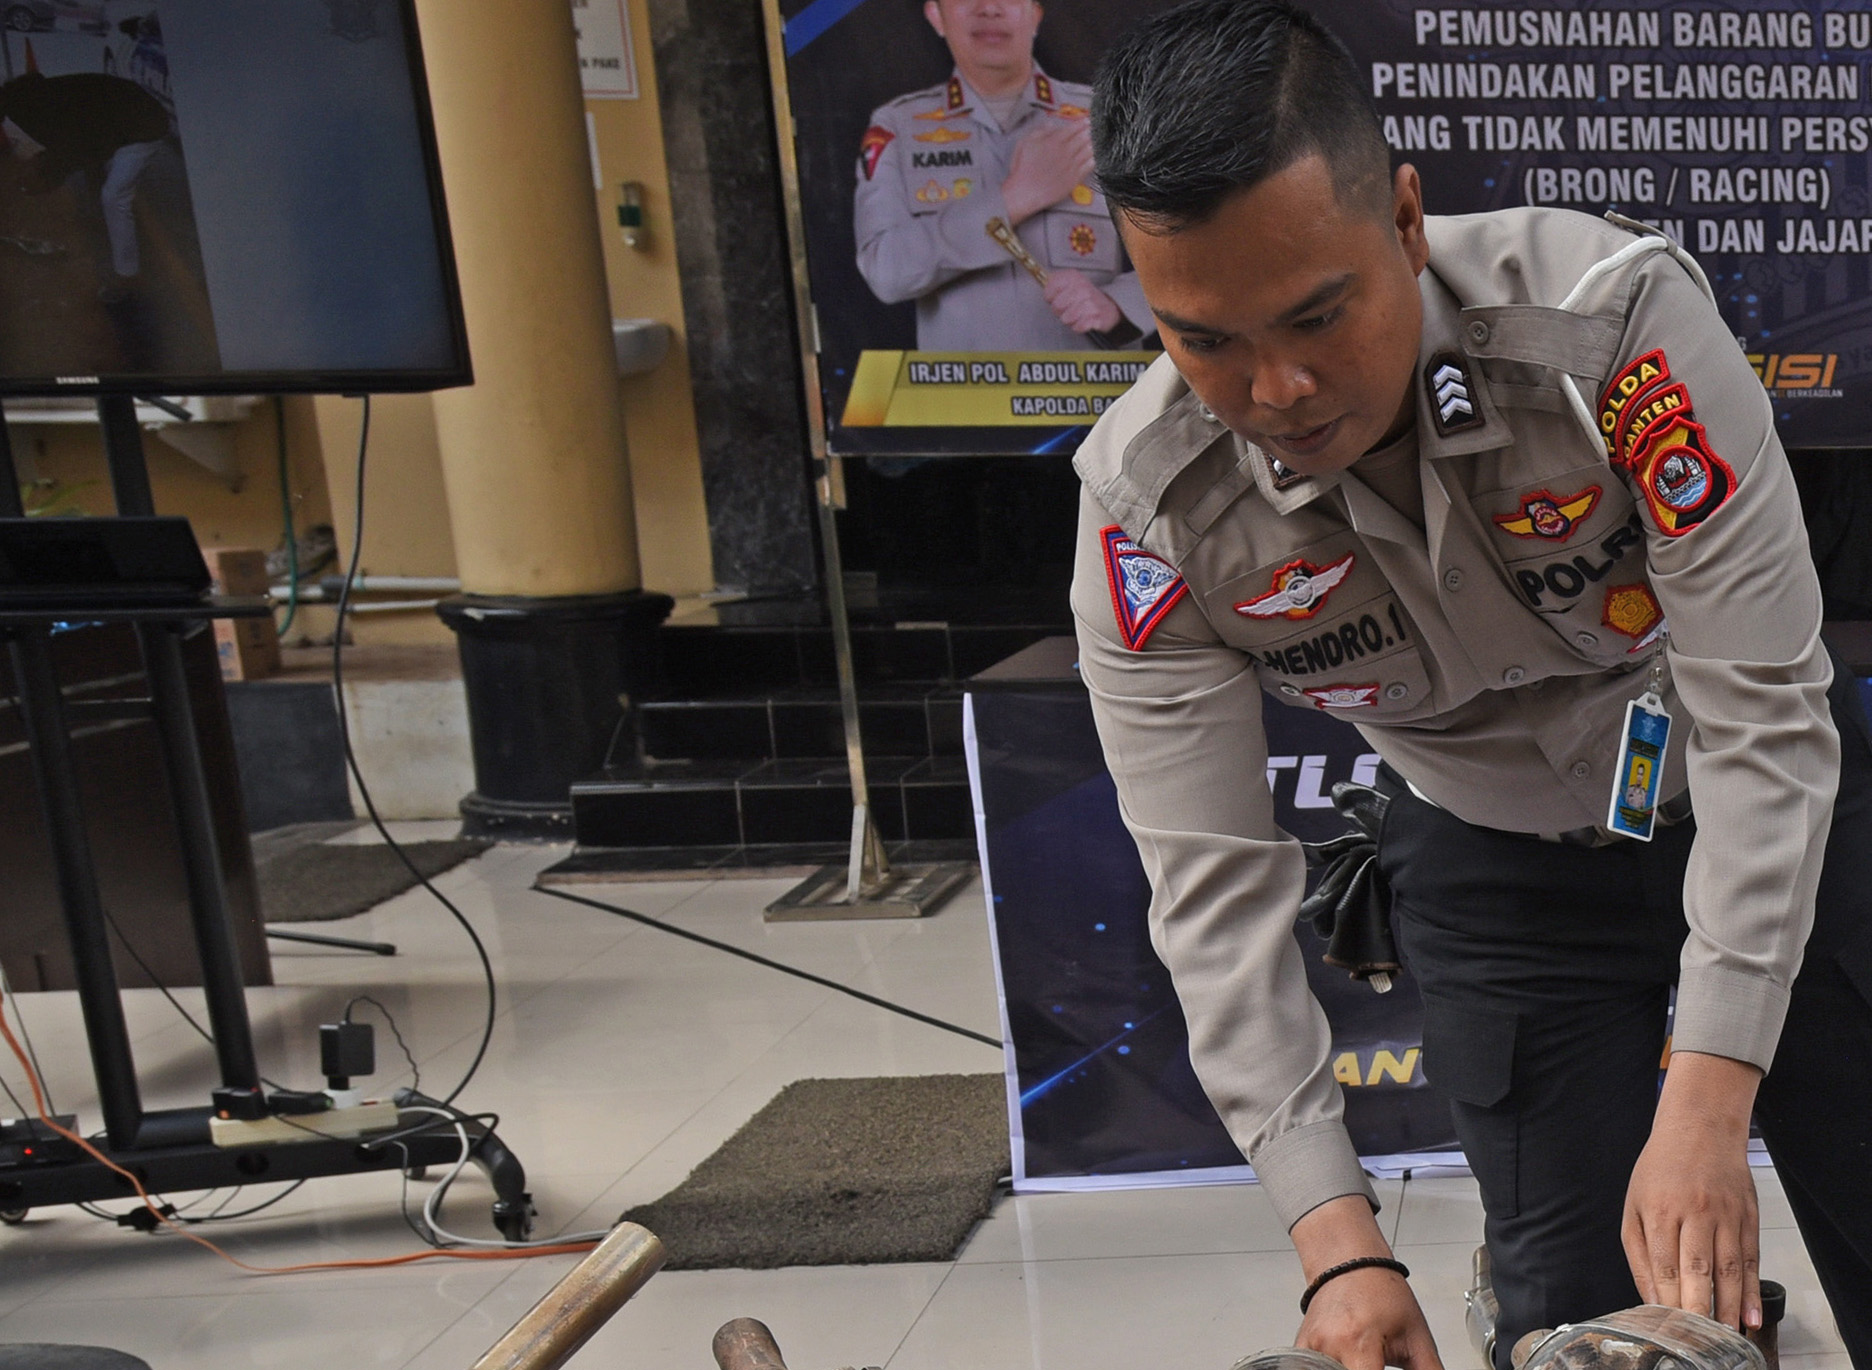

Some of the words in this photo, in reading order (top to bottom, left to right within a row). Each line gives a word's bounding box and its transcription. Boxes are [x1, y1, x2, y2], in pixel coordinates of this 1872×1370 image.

[1415, 10, 1664, 48] PEMUSNAHAN
[1673, 12, 1813, 50] BARANG
[1373, 63, 1600, 99] PENINDAKAN
[1609, 64, 1858, 101] PELANGGARAN
[1381, 115, 1452, 151] ANG
[1463, 116, 1568, 151] TIDAK
[1576, 116, 1768, 152] MEMENUHI
[913, 149, 973, 169] KARIM
[1523, 168, 1655, 205] (BRONG
[1665, 167, 1679, 207] /
[1690, 168, 1831, 208] RACING)
[1699, 218, 1766, 254] DAN
[910, 362, 966, 383] IRJEN
[972, 363, 1009, 383] POL
[1019, 363, 1081, 383] ABDUL
[1012, 397, 1088, 415] KAPOLDA
